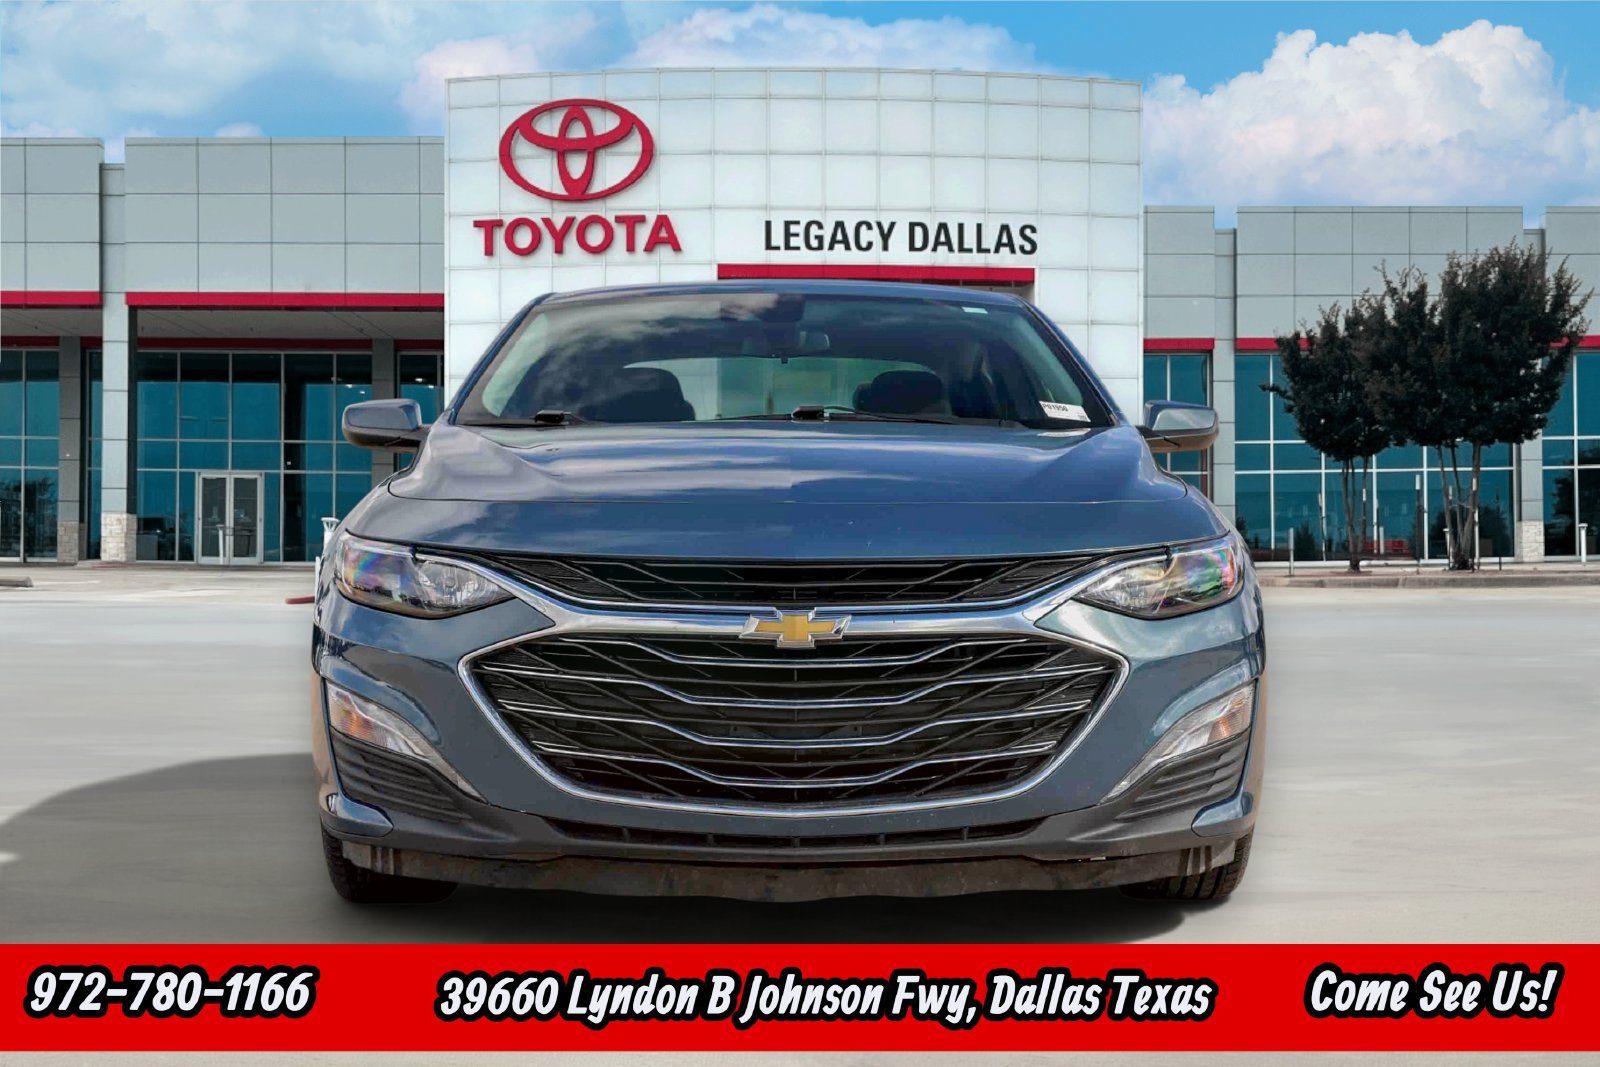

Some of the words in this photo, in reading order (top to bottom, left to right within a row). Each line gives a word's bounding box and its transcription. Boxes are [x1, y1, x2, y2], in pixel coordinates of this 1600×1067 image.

[474, 214, 682, 257] TOYOTA
[765, 220, 897, 252] LEGACY
[908, 221, 1038, 255] DALLAS
